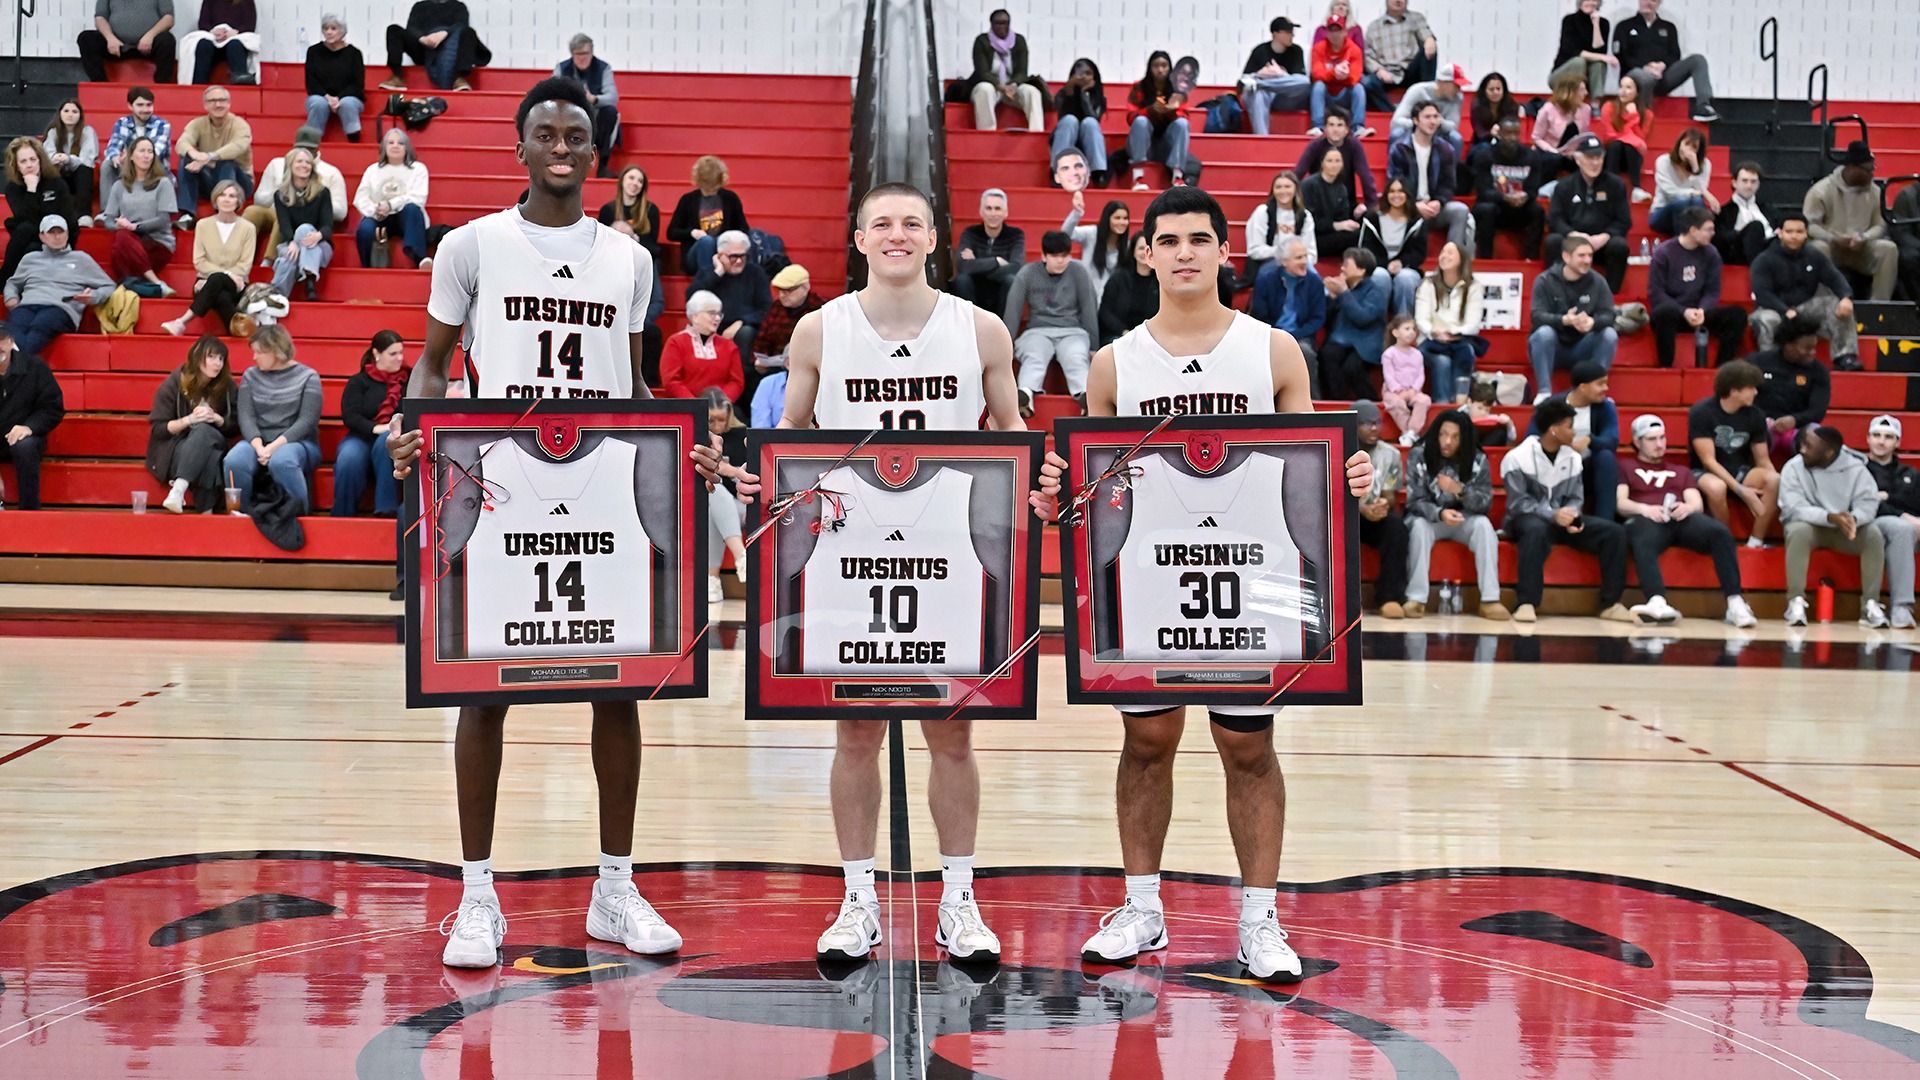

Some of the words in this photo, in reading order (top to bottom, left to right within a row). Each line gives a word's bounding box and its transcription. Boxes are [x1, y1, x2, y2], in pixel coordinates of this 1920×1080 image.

[504, 296, 617, 329] URSINUS
[537, 330, 584, 380] 14
[845, 375, 958, 402] URSINUS
[1139, 393, 1249, 415] URSINUS
[1634, 468, 1677, 488] VT
[503, 532, 615, 556] URSINUS
[1154, 543, 1264, 566] URSINUS
[840, 557, 948, 580] URSINUS
[534, 561, 586, 612] 14
[1180, 572, 1241, 619] 30
[868, 585, 918, 633] 10
[504, 619, 615, 646] COLLEGE
[1157, 627, 1266, 650] COLLEGE
[838, 641, 946, 664] COLLEGE
[531, 668, 566, 676] MOHAMED
